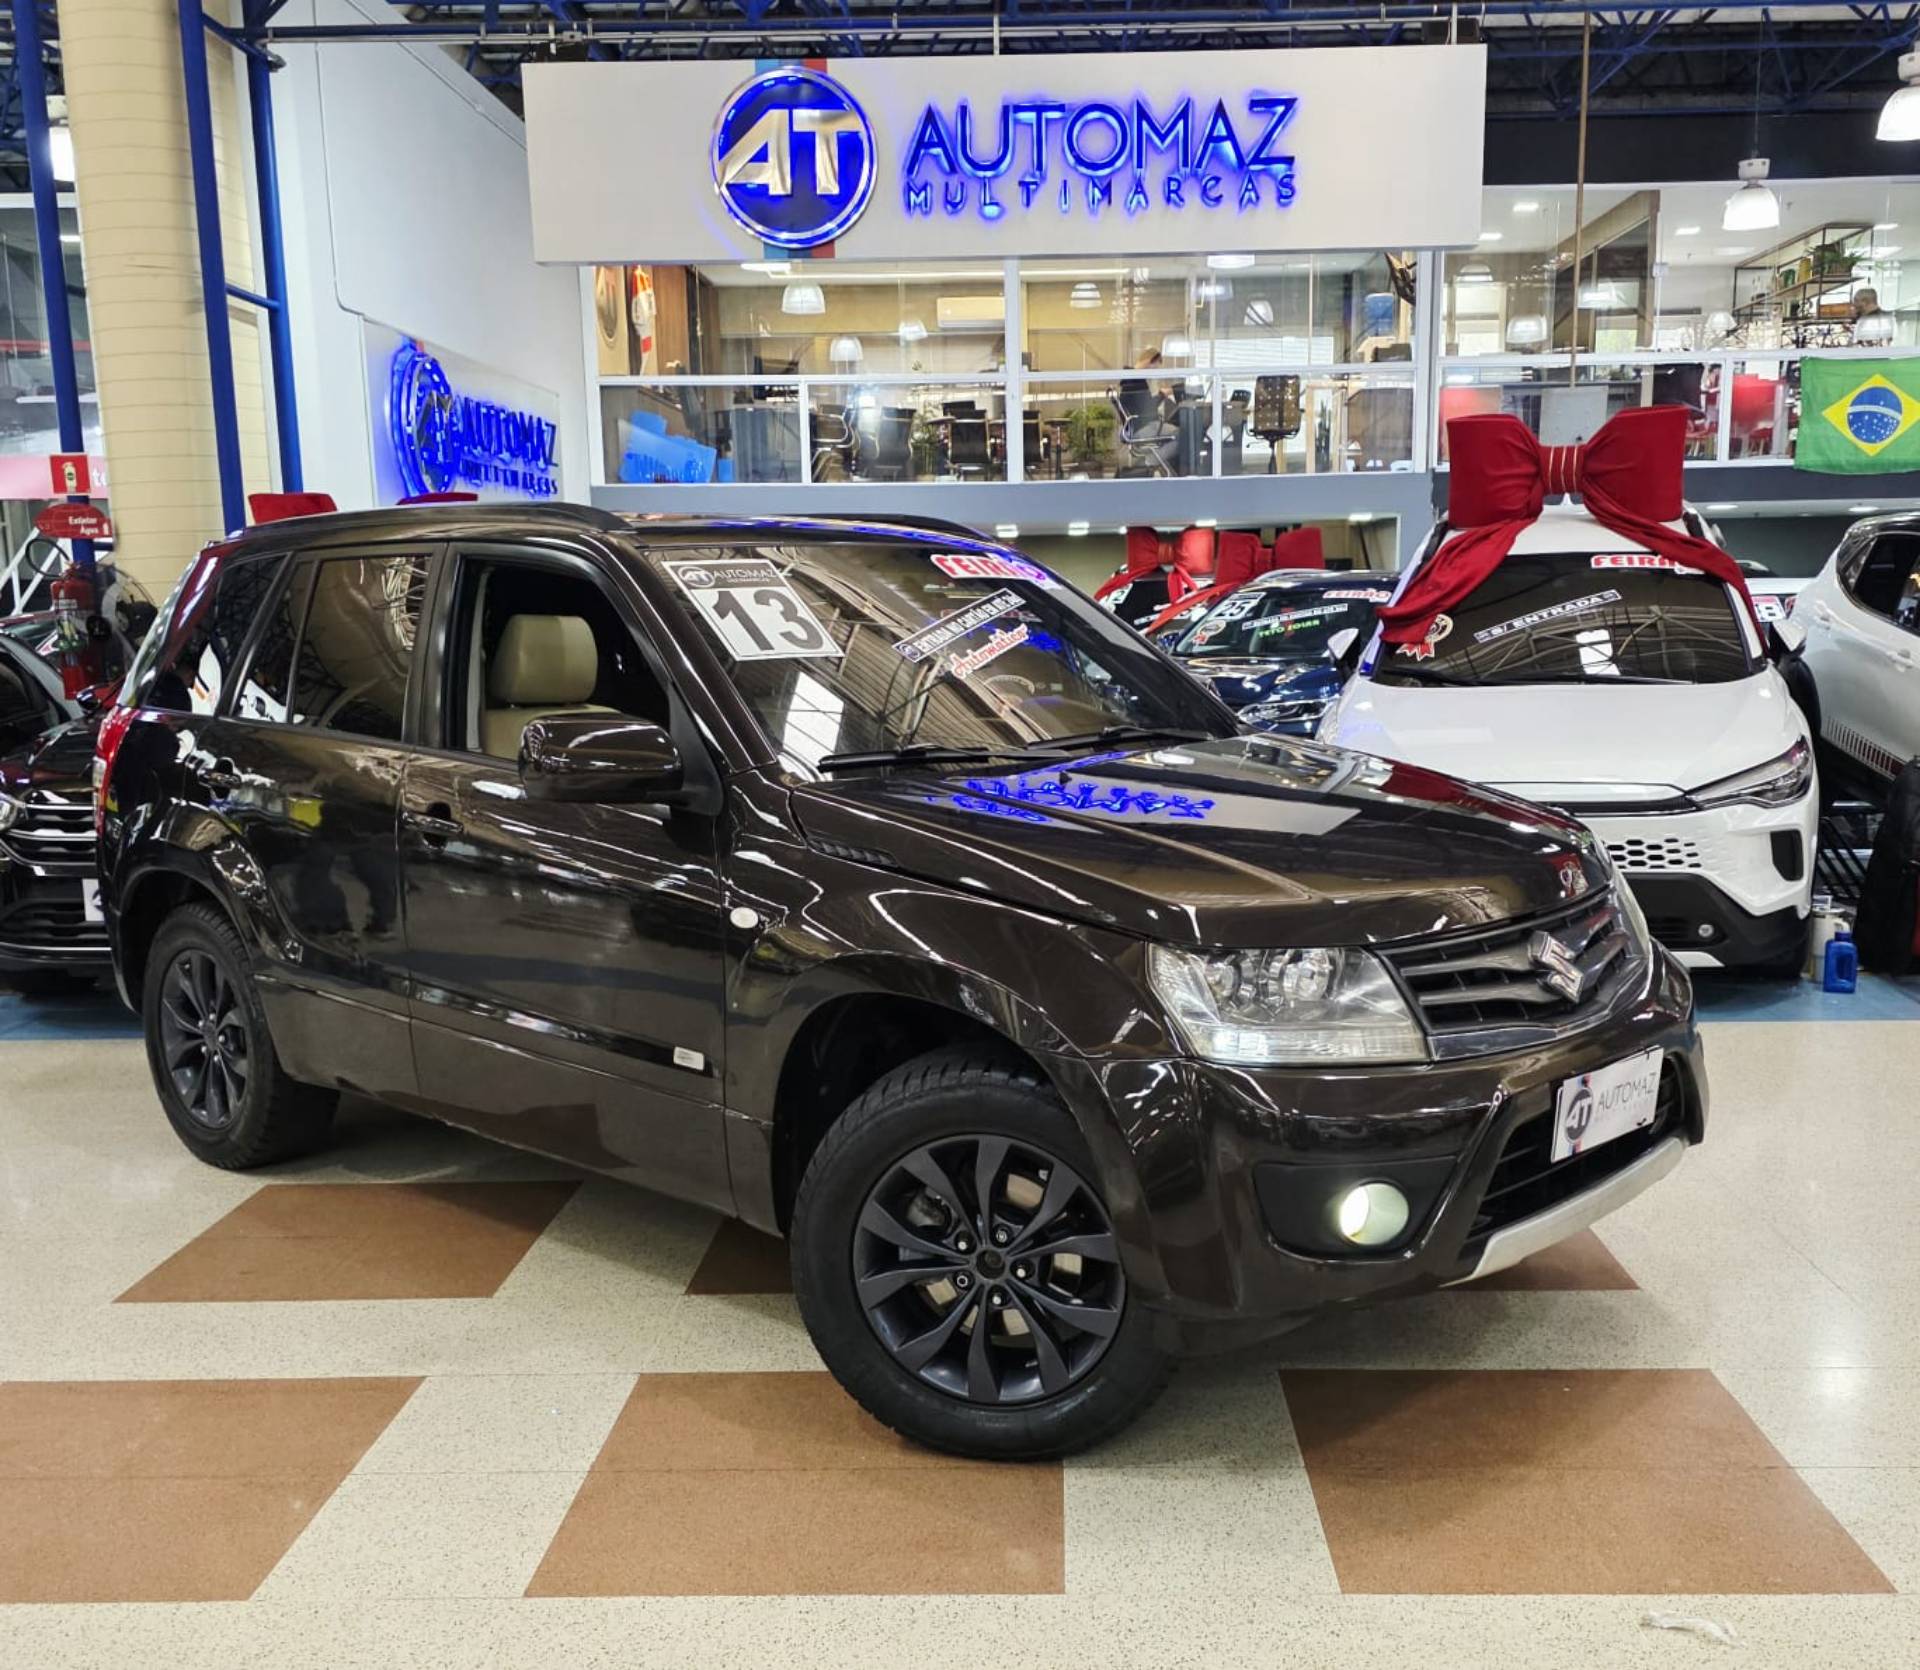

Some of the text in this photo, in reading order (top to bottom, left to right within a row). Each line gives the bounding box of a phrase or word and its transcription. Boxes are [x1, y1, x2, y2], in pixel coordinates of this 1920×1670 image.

[717, 97, 1298, 196] AT AUTOMAZ
[908, 175, 1297, 208] MULTIMARCAS
[714, 569, 777, 580] AUTOMAZ
[712, 589, 824, 651] 13
[1512, 597, 1604, 629] ENTRADA
[1596, 1072, 1657, 1112] AUTOMAZ
